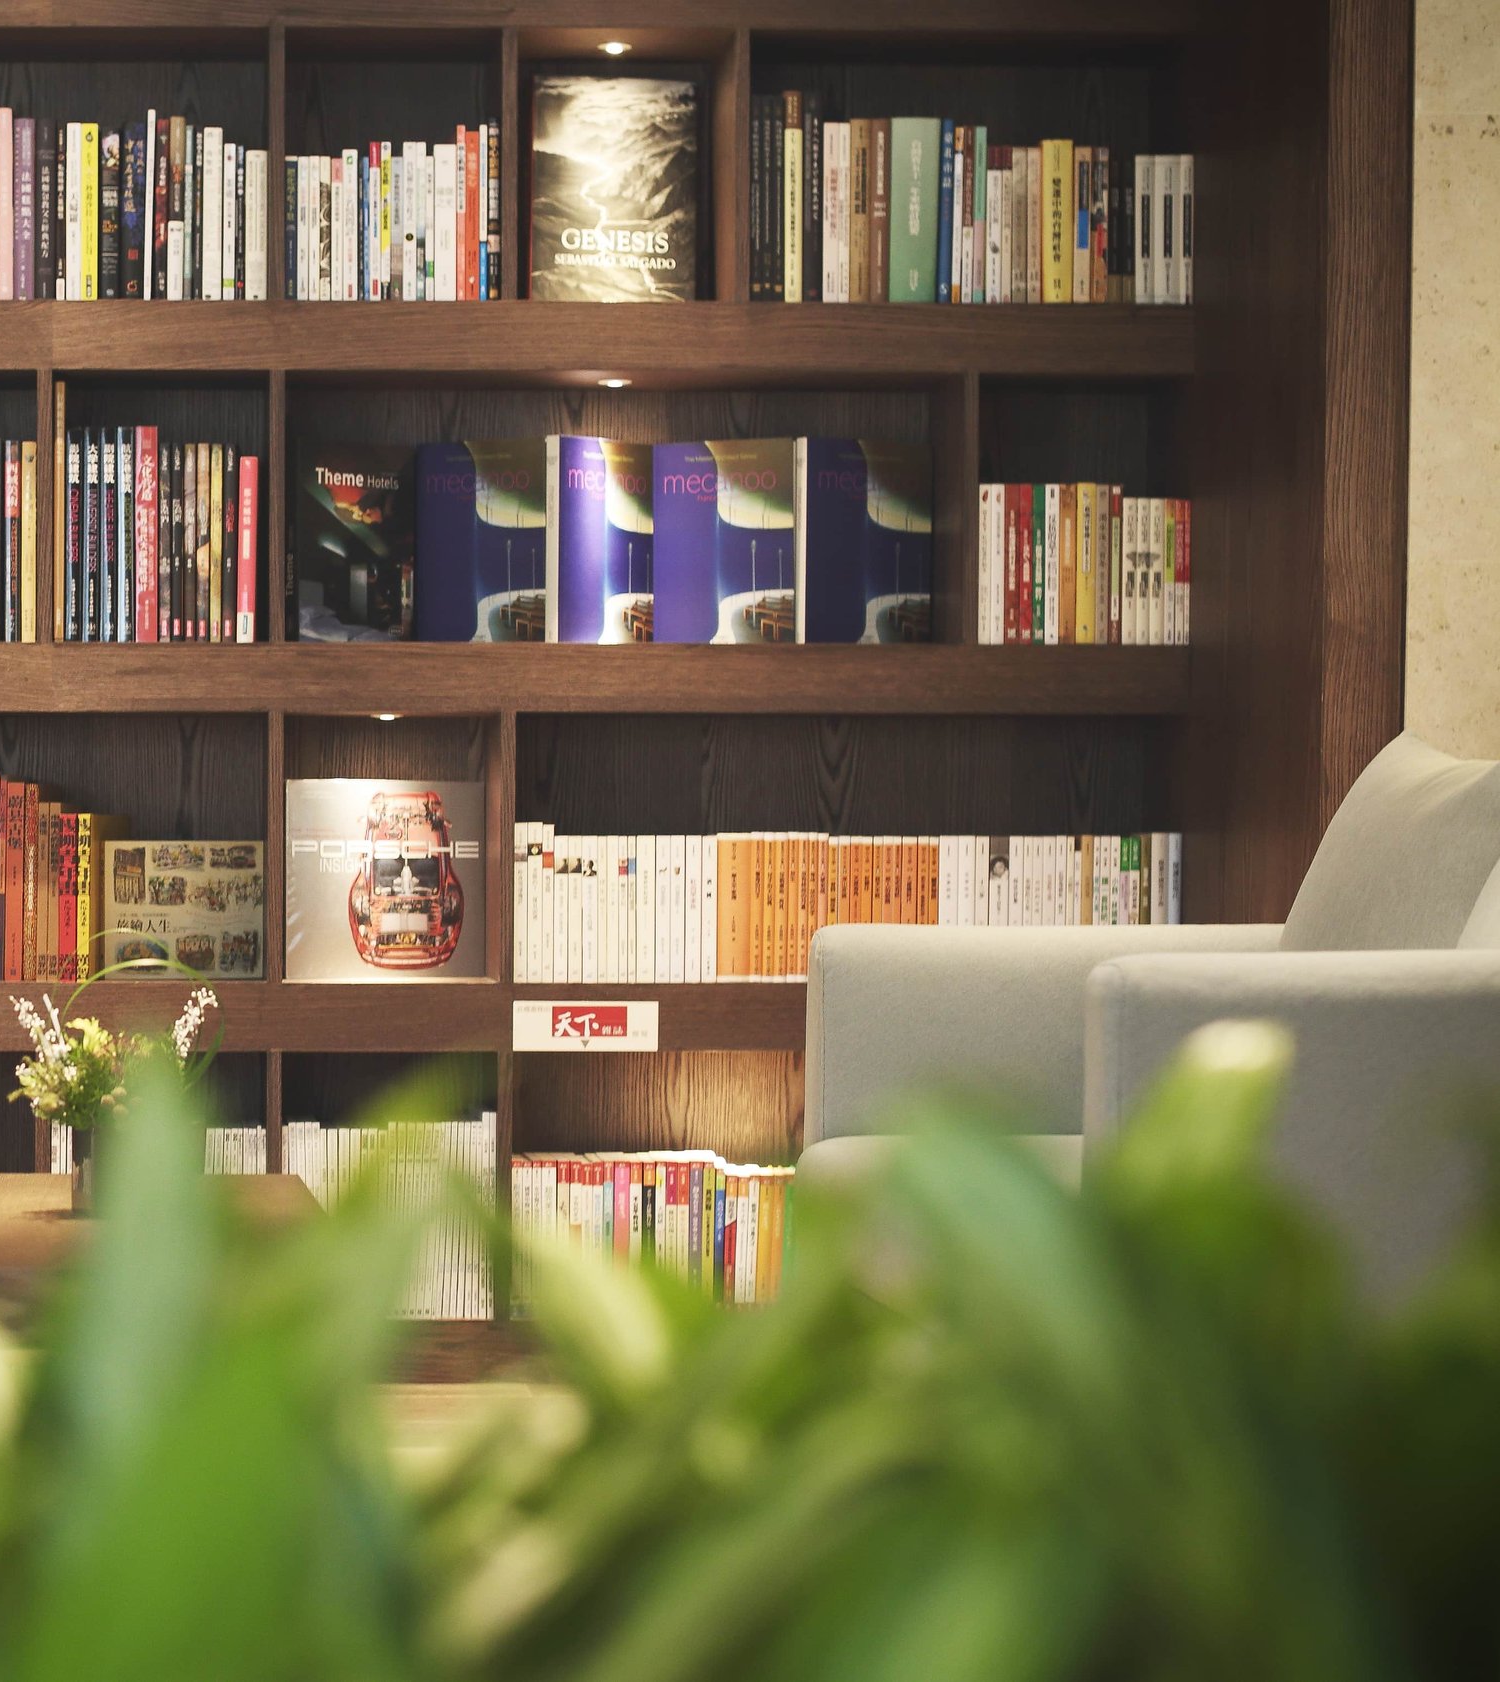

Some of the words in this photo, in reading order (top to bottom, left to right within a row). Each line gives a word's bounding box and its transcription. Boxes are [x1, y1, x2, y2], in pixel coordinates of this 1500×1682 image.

[561, 228, 670, 254] GENESIS
[315, 467, 364, 488] Theme
[367, 474, 399, 491] Hotels
[568, 468, 647, 494] mecnoo
[291, 841, 480, 859] PORSCHE
[554, 1011, 597, 1037] 天下
